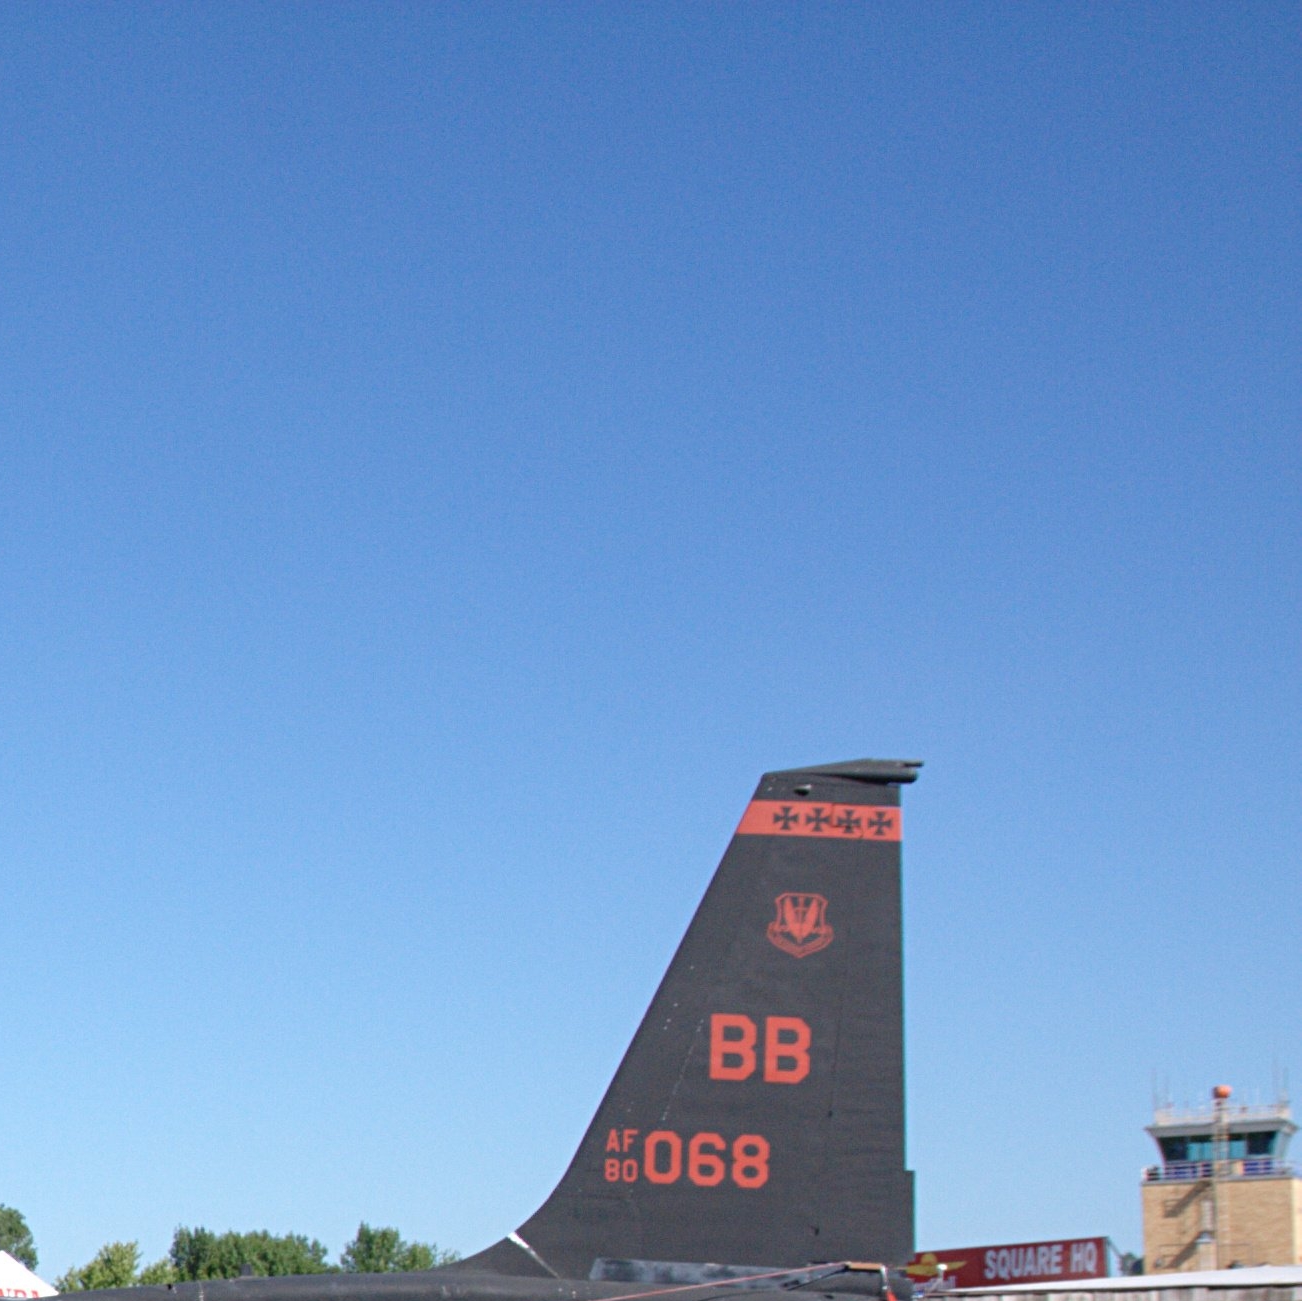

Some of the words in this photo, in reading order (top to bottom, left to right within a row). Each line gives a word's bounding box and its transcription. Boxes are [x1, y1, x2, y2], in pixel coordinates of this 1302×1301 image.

[709, 1013, 812, 1085] BB
[605, 1128, 639, 1153] AF
[643, 1129, 771, 1189] 068
[604, 1157, 639, 1183] 80
[983, 1244, 1063, 1281] SQUARE
[1070, 1241, 1098, 1274] HQ
